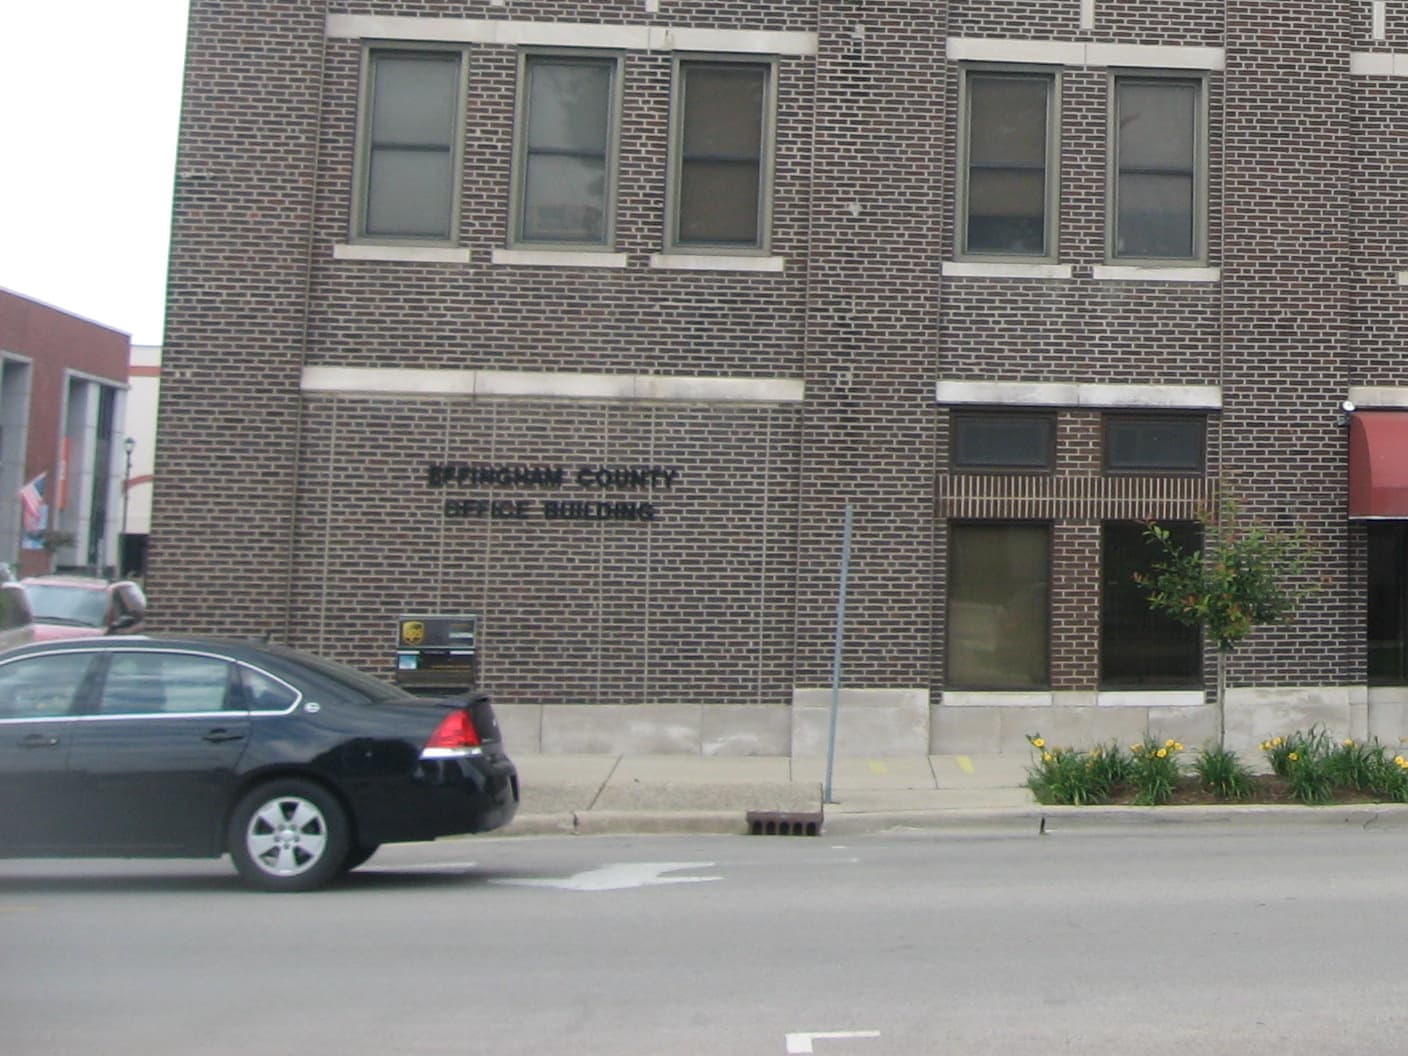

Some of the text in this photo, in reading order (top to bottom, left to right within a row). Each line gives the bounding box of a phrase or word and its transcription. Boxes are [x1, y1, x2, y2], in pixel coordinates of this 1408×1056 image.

[428, 465, 677, 489] EFFINGHAM COUNTY
[443, 500, 655, 521] OFFICE BUILDING
